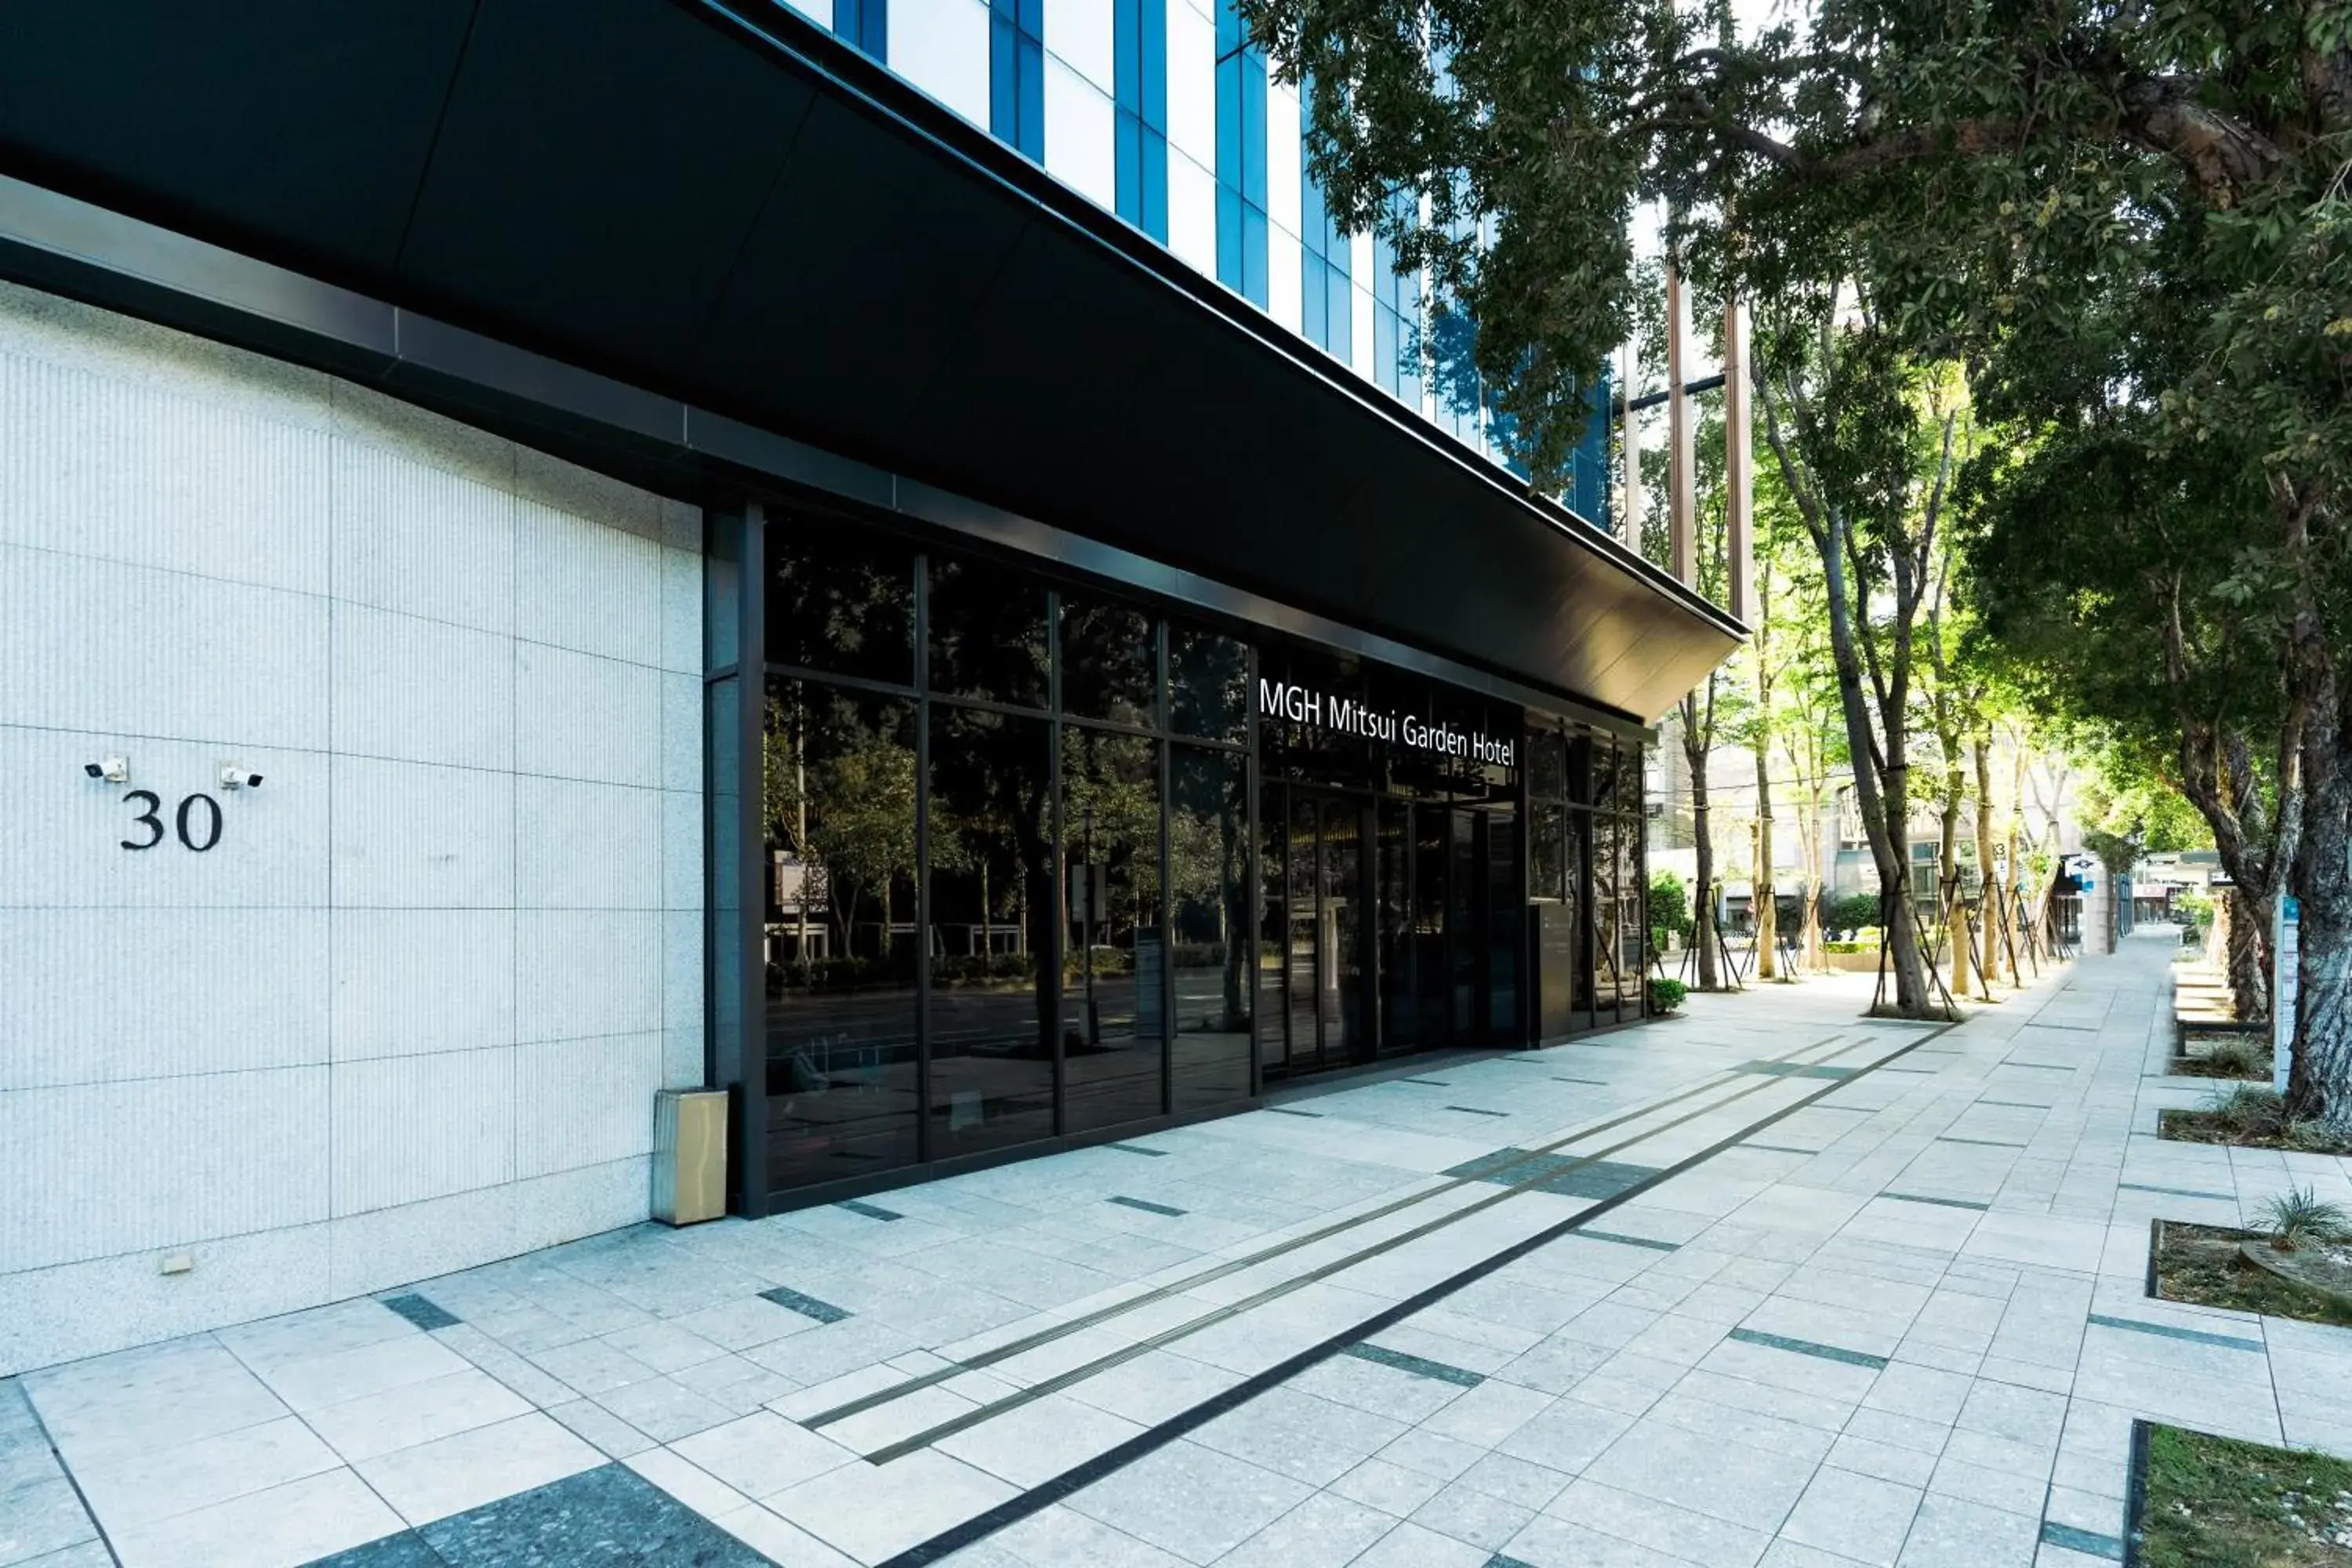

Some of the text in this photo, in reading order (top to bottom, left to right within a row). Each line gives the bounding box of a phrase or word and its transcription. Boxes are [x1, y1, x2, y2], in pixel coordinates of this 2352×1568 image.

[1259, 678, 1515, 766] MGH Mitsui Garden Hotel
[121, 789, 222, 851] 30
